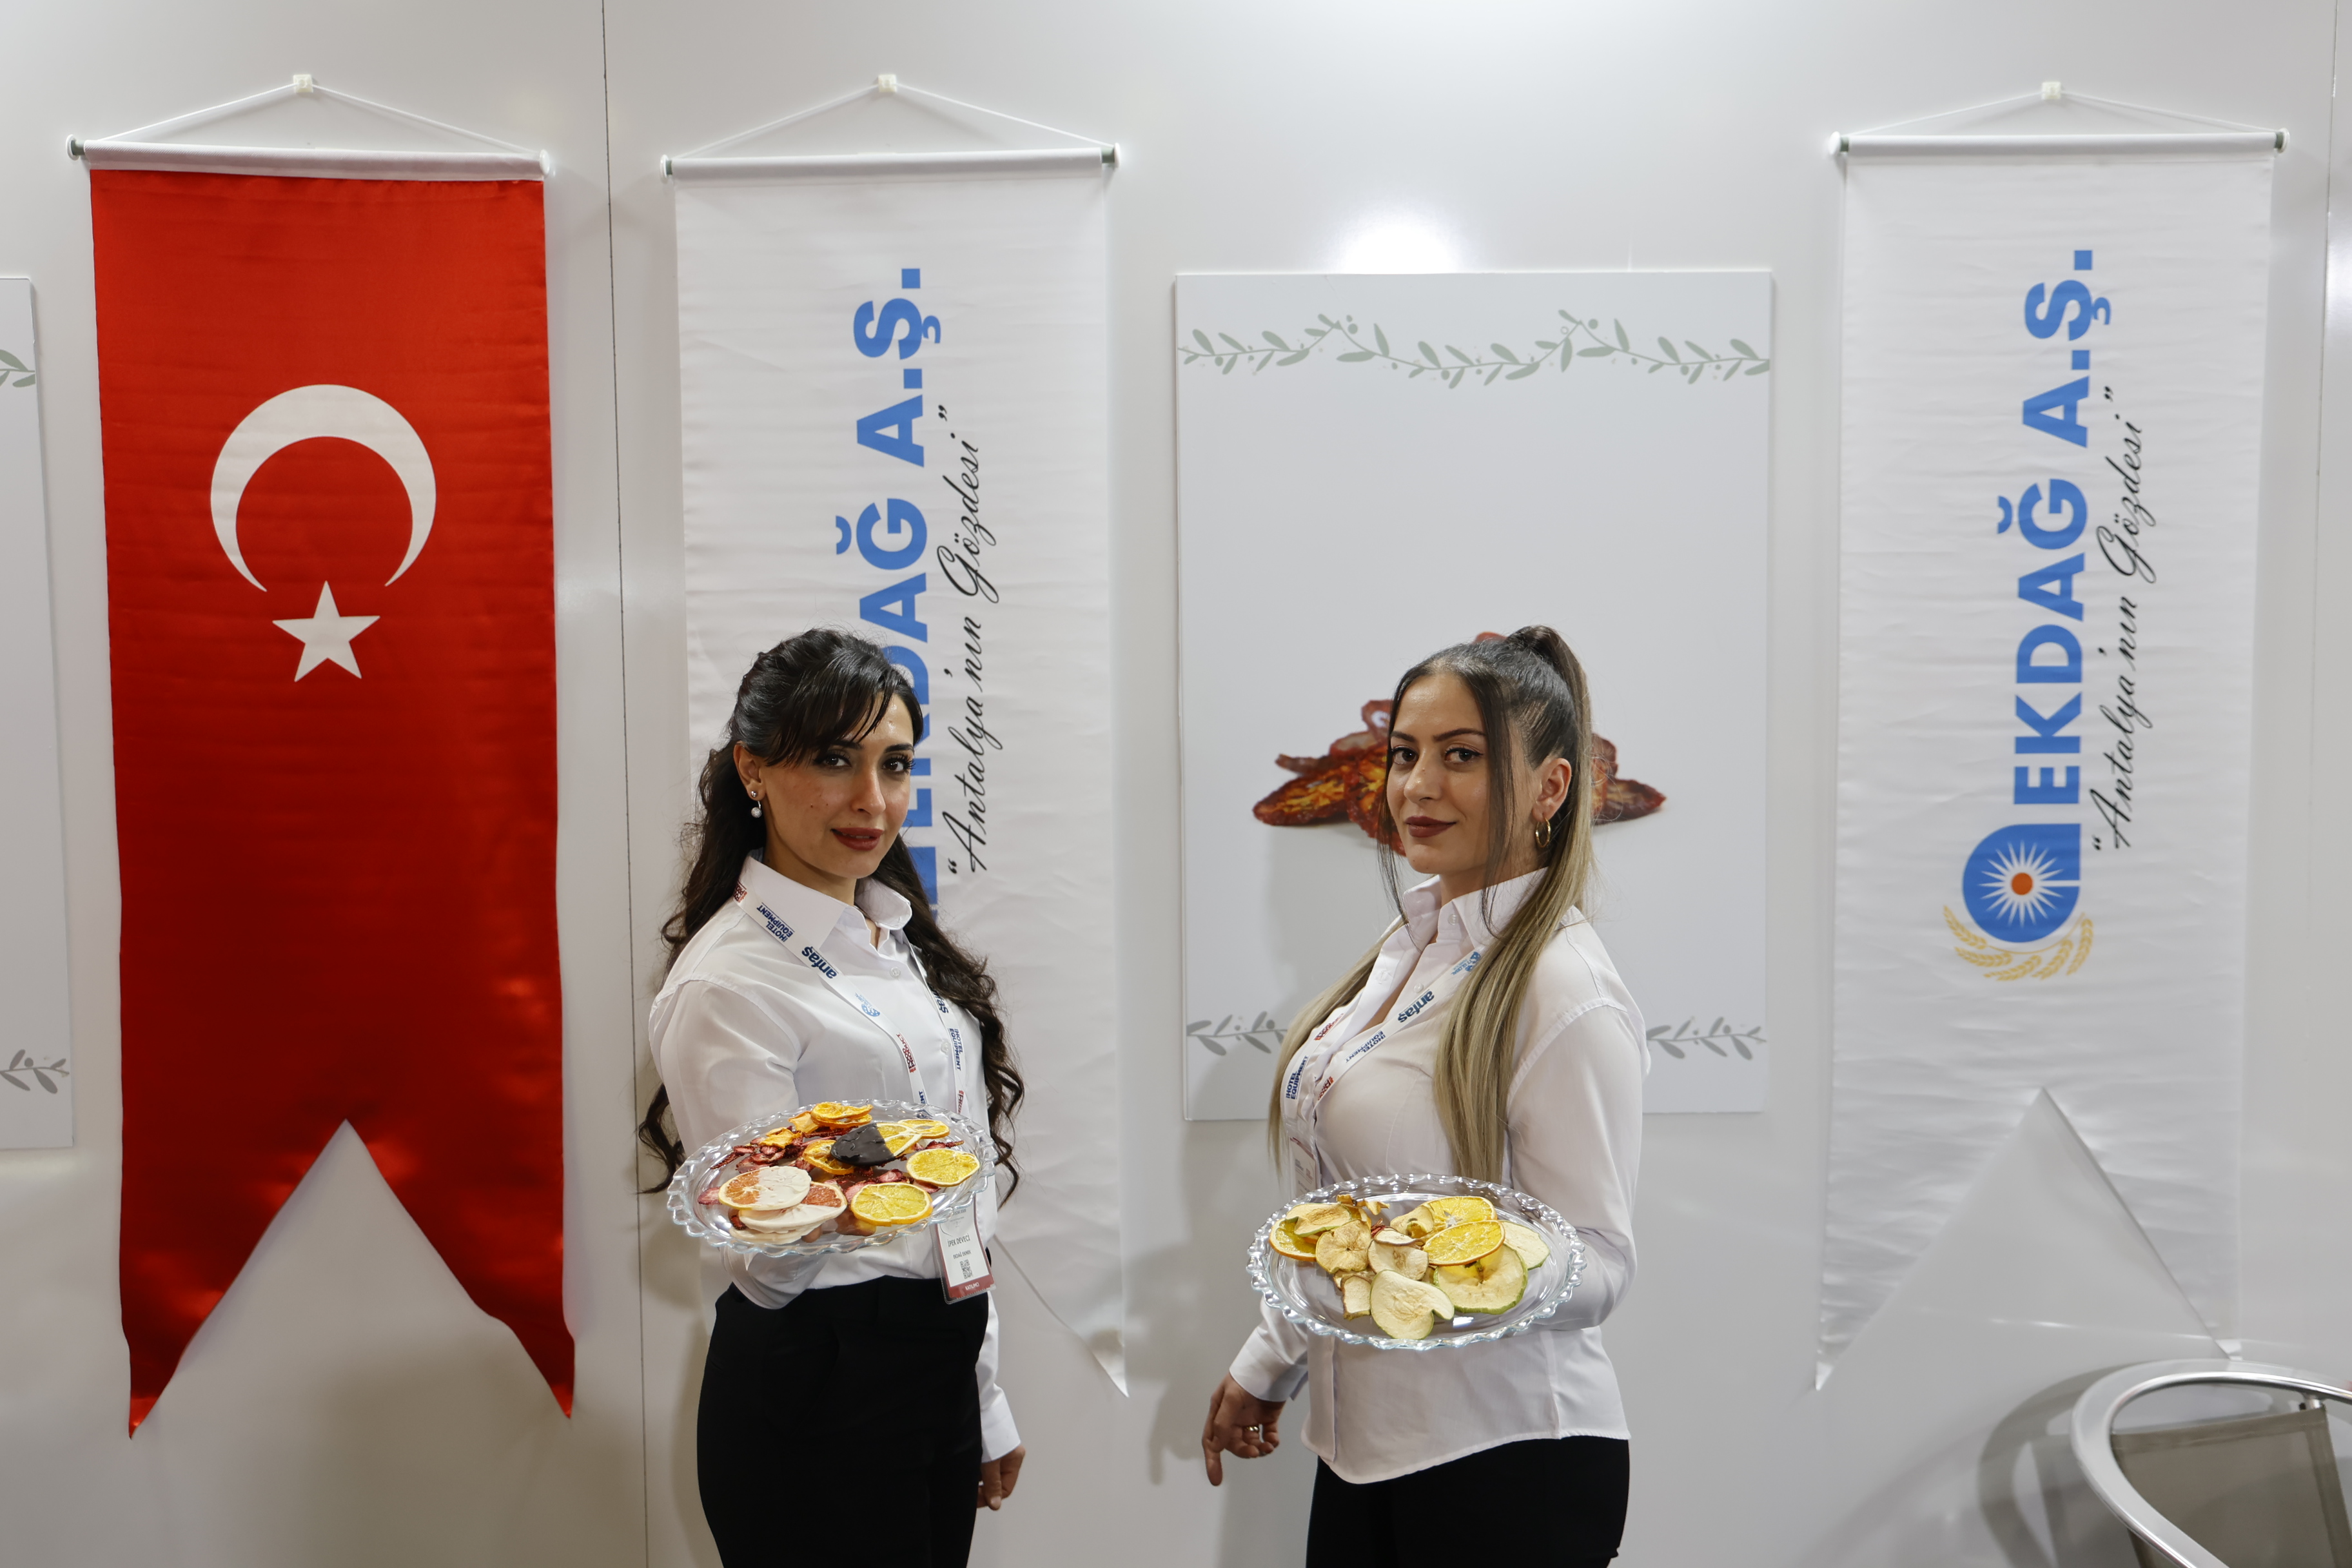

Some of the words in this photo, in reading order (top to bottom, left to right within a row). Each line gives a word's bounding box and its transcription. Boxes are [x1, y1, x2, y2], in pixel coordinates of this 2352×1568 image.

[2023, 250, 2112, 447] A.Ş.
[854, 269, 941, 466] A.Ş.
[1997, 479, 2088, 805] EKDAĞ
[756, 905, 794, 937] EQUIPMENT
[801, 946, 838, 979] anfaş
[1397, 990, 1435, 1023] anfaş
[949, 1028, 961, 1070] EQUIPMENT
[1344, 1030, 1384, 1063] EQUIPMENT
[1291, 1055, 1308, 1099] EQUIPMENT
[956, 1233, 970, 1244] DEVECİ
